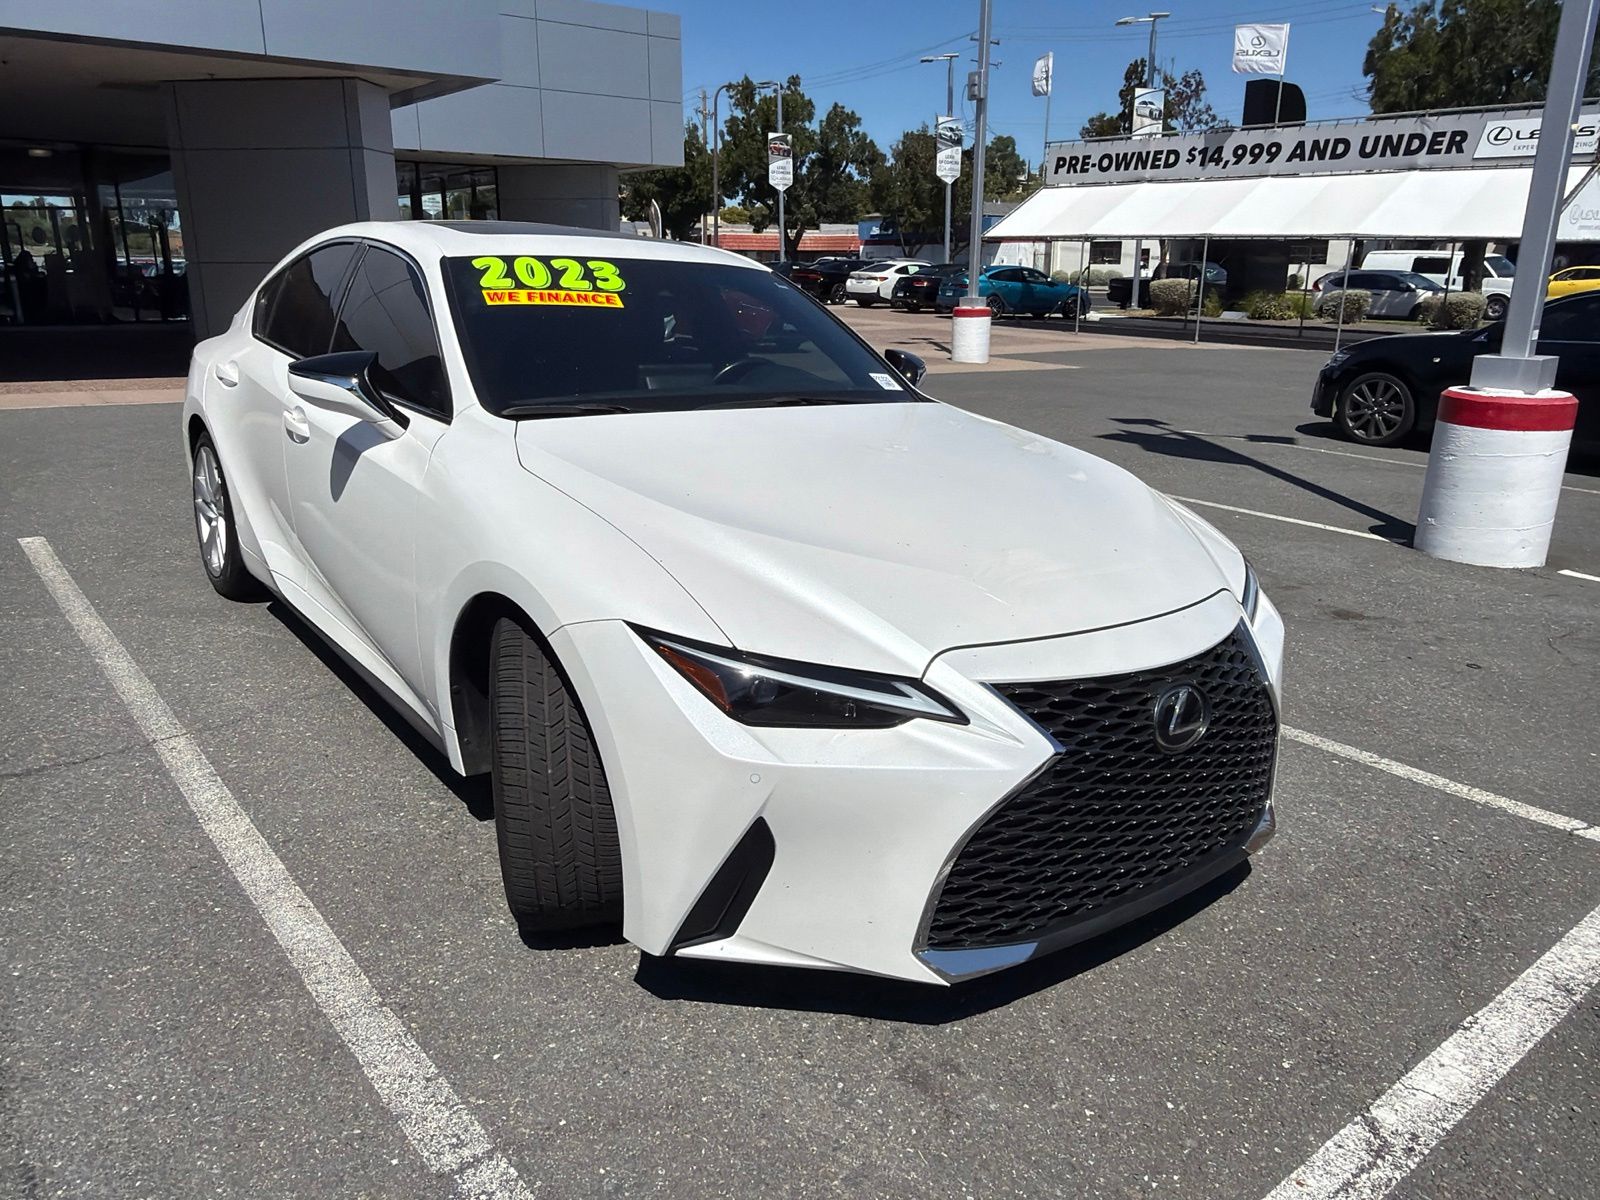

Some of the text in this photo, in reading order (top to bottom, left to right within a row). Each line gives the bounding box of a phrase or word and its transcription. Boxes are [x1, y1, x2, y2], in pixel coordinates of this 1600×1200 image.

[1516, 126, 1596, 140] LES
[1054, 130, 1468, 175] PRE-OWNED $14,999 AND UNDER
[471, 256, 625, 291] 2023
[486, 291, 618, 305] WE FINANCE
